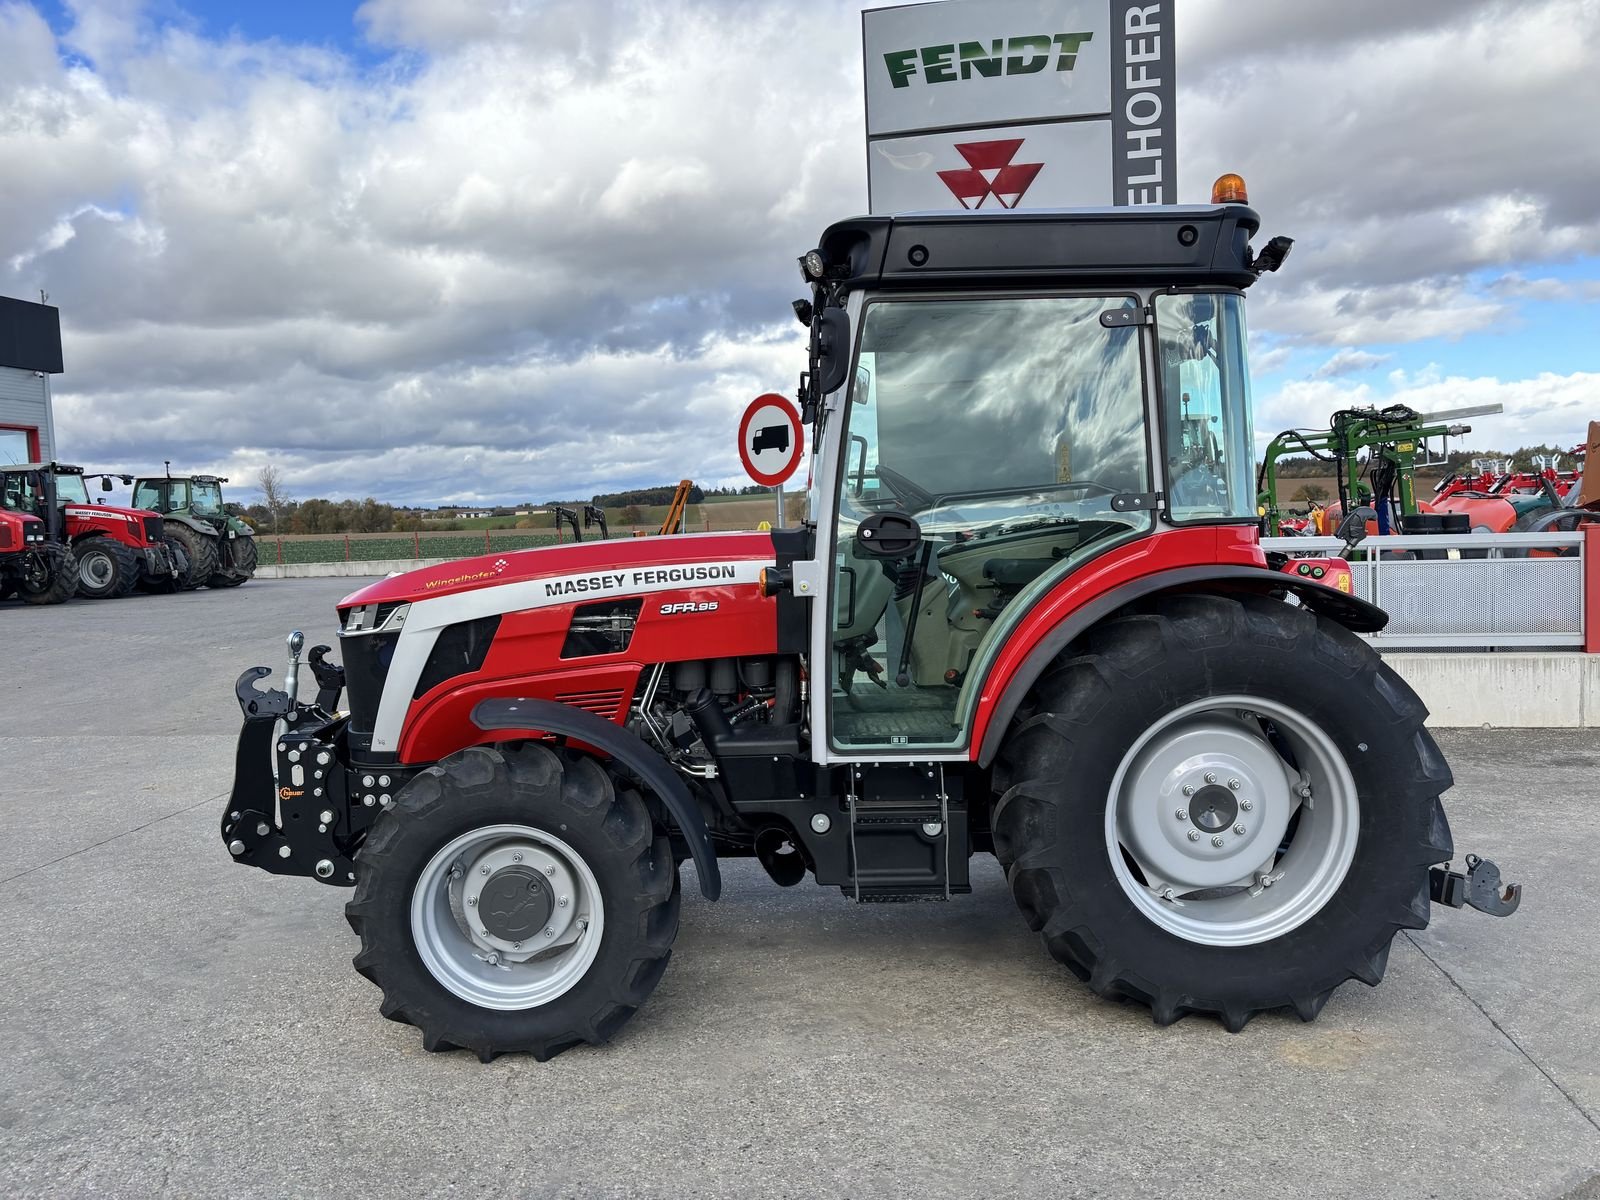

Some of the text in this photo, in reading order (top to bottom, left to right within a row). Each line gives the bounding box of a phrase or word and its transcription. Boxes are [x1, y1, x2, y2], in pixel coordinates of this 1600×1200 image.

[883, 31, 1094, 89] FENDT
[426, 571, 496, 590] Wingelhofer
[545, 565, 736, 597] MASSEY FERGUSON
[659, 601, 719, 615] 3FR.95
